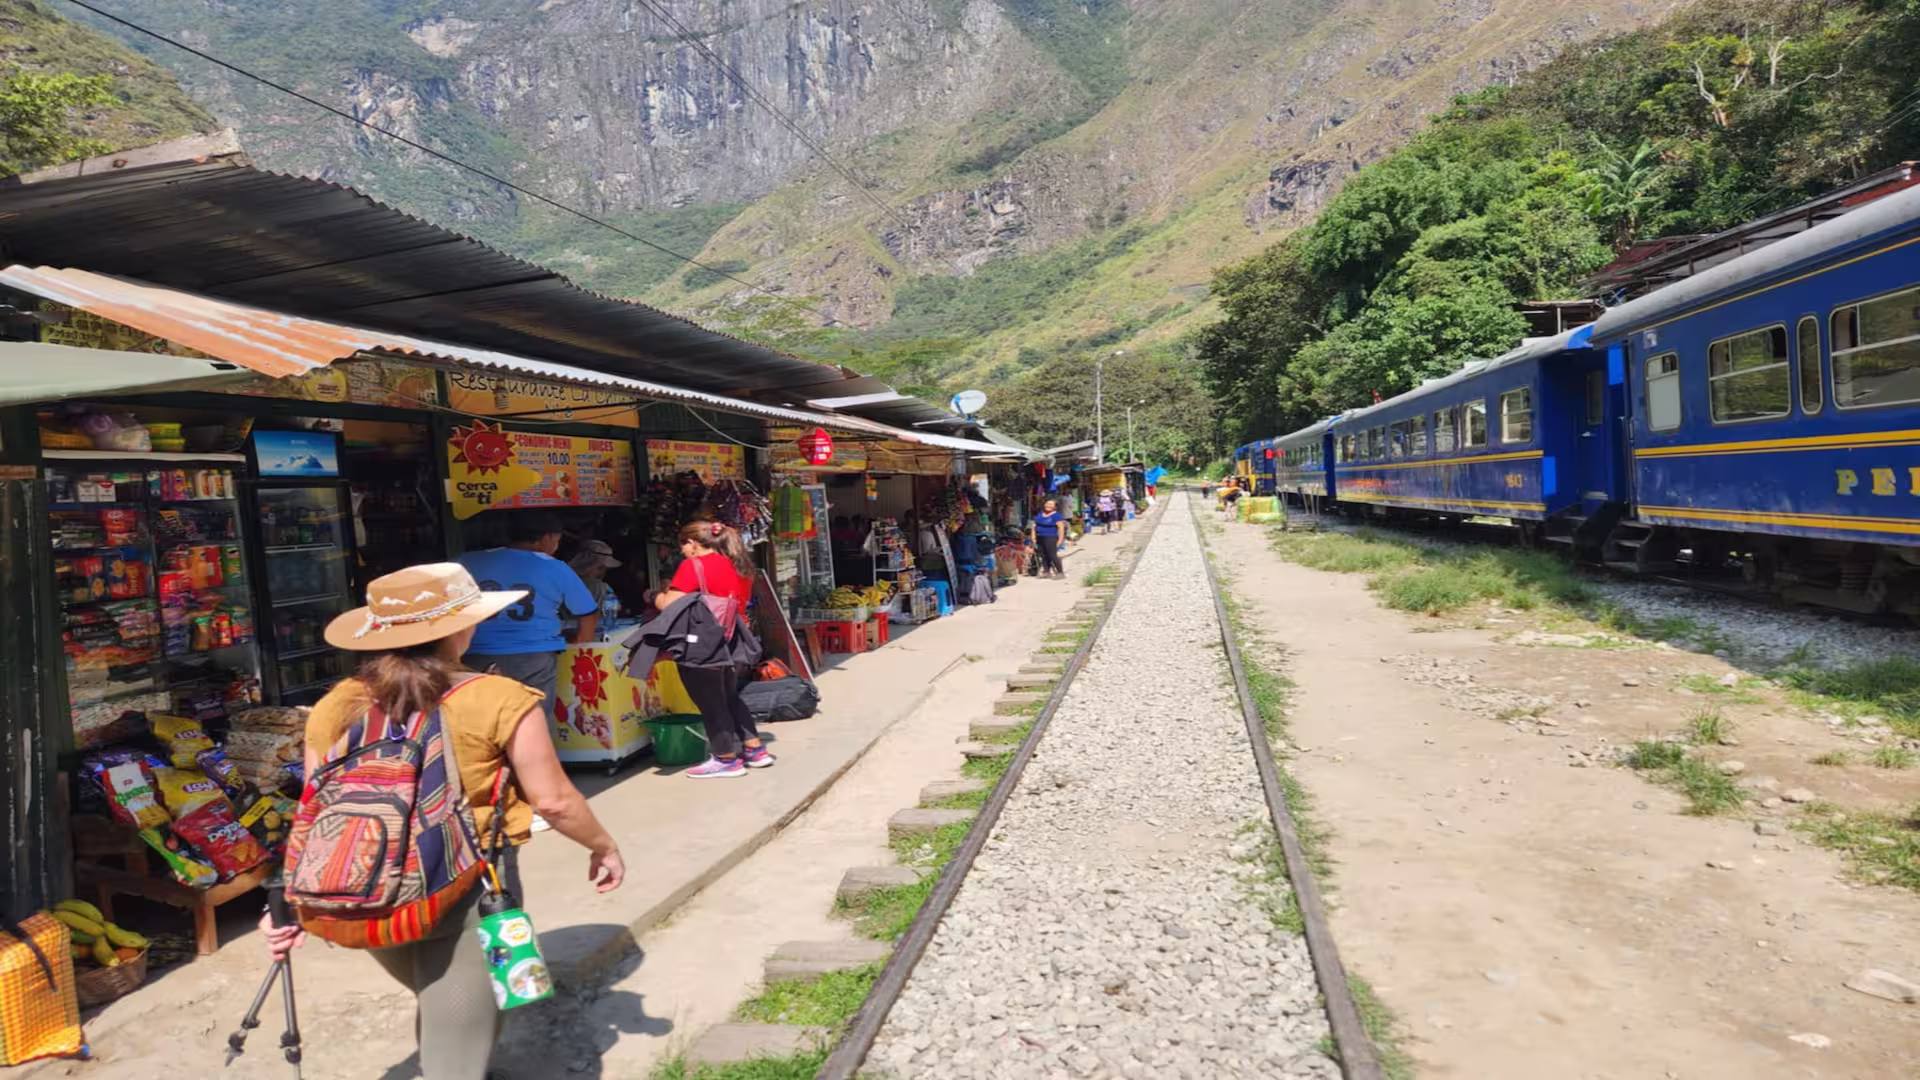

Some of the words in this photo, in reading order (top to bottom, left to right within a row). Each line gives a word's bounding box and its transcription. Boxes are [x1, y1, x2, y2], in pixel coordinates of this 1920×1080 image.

[450, 371, 566, 401] Resturante
[547, 452, 571, 465] 10.00
[456, 482, 498, 492] Cerca
[462, 490, 477, 498] de
[477, 491, 492, 504] ti
